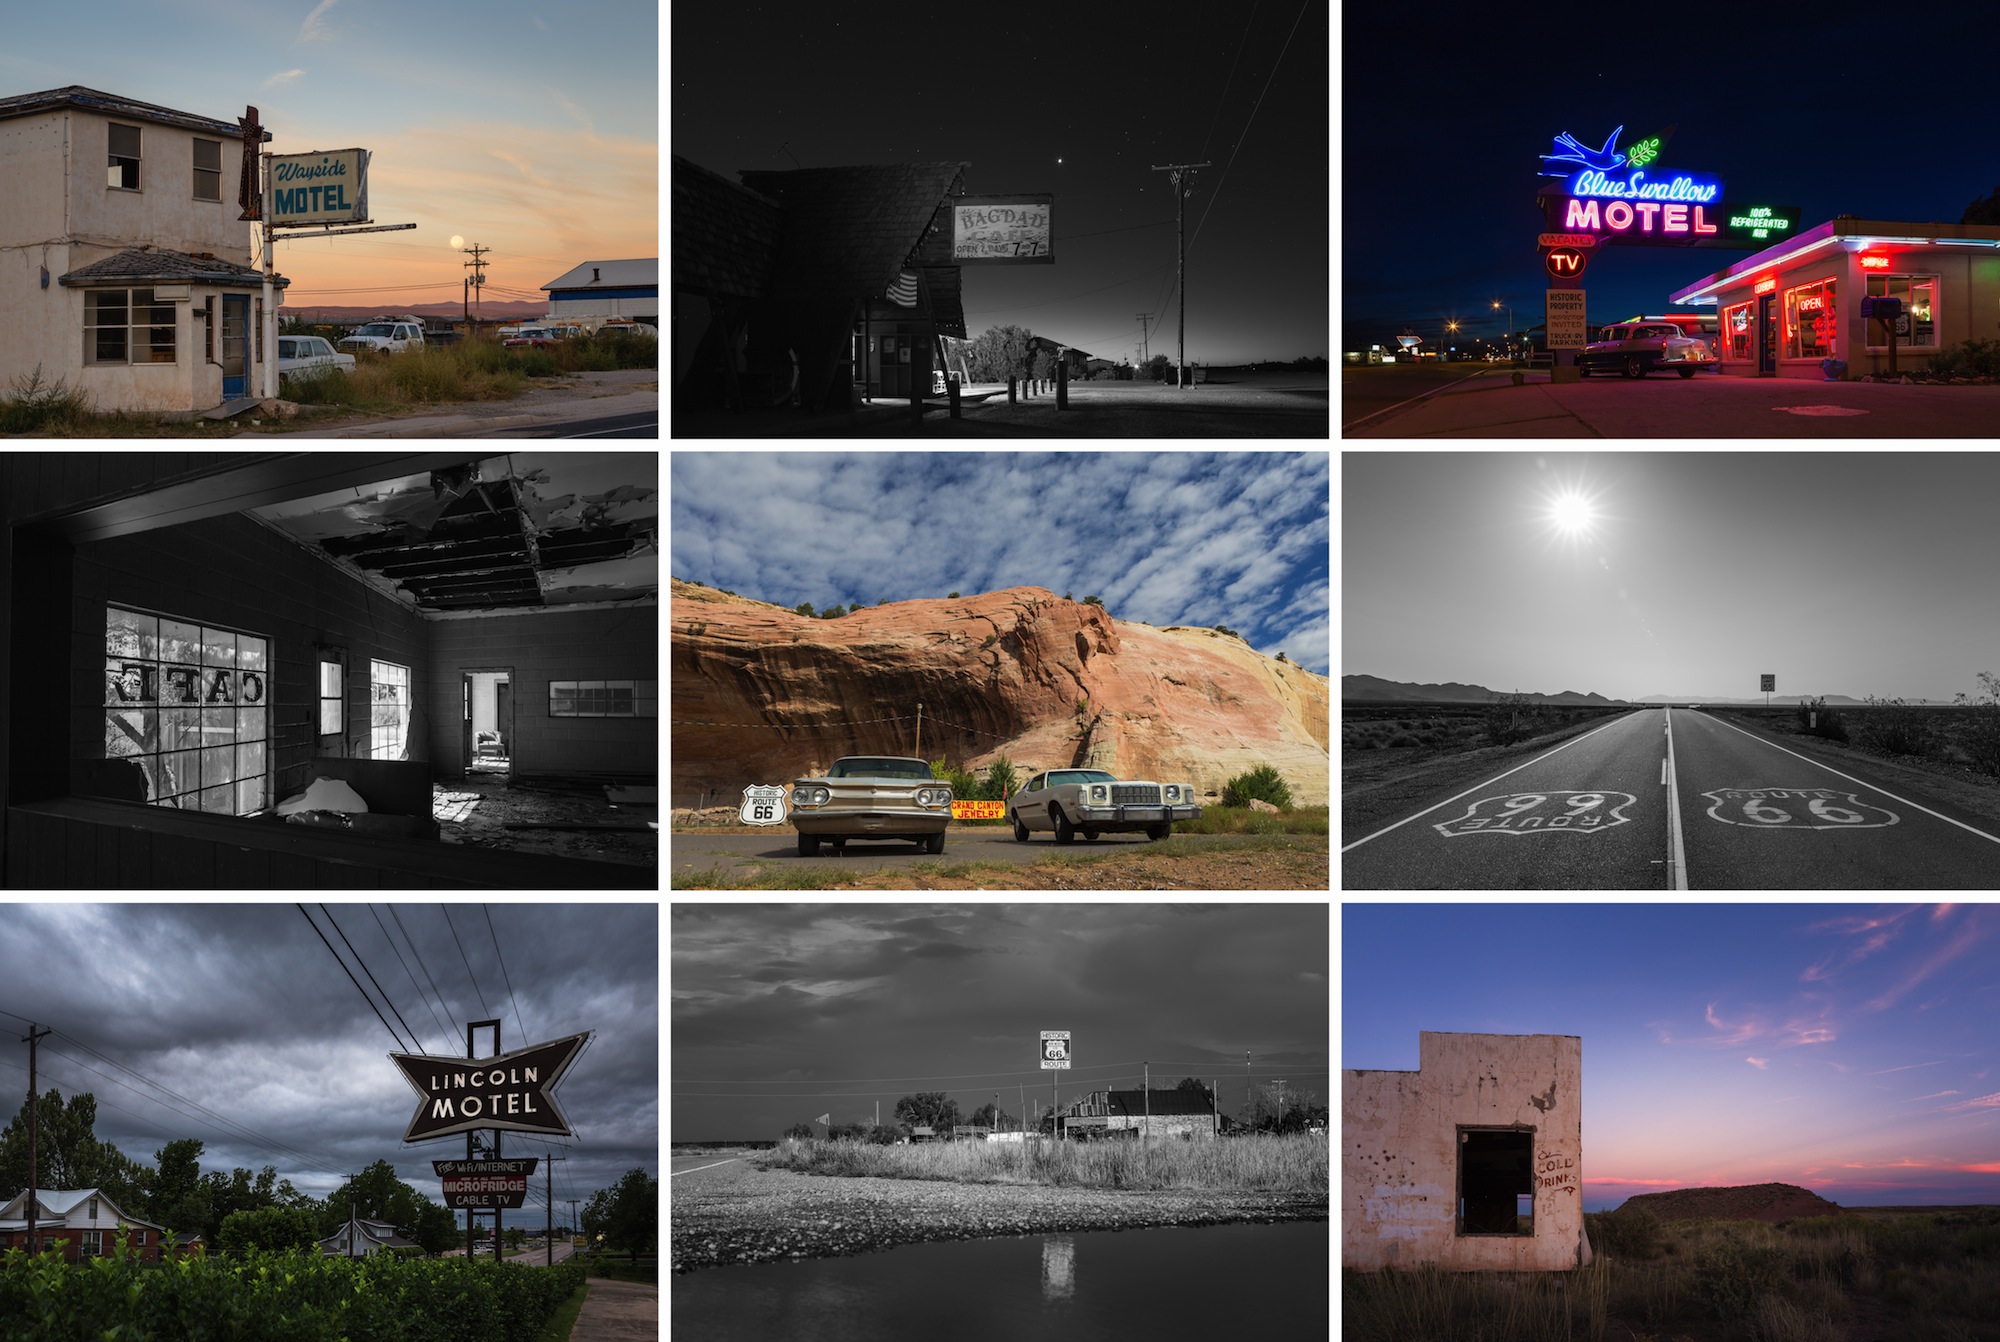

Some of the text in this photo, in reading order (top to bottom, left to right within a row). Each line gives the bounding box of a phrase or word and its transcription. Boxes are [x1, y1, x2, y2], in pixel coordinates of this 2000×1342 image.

[274, 157, 346, 182] Wayside
[1575, 170, 1717, 202] Blue Swallow
[275, 184, 352, 215] MOTEL
[961, 208, 1047, 230] BAGDAD
[1565, 199, 1718, 233] MOTEL
[1730, 216, 1789, 230] REFRIGERATED
[1541, 235, 1593, 245] VACANCY
[1013, 242, 1020, 256] 7
[1031, 242, 1038, 256] 7
[1551, 255, 1580, 270] TV
[1549, 293, 1583, 301] HISTORIC
[1800, 297, 1822, 311] OPEN
[1549, 302, 1584, 311] PROPERTY
[1551, 321, 1583, 329] INVITED
[1550, 339, 1584, 347] PARKING
[752, 798, 777, 806] ROUTE
[1725, 790, 1837, 800] ROUTE
[951, 800, 1005, 810] GRAND CANYON
[1742, 799, 1865, 824] 66
[753, 805, 774, 820] 66
[957, 809, 1000, 819] JEWELRY
[1459, 815, 1603, 830] ROUTE
[1049, 1050, 1062, 1058] 66
[431, 1066, 538, 1091] LINCOLN
[431, 1092, 537, 1119] MOTEL
[443, 1181, 525, 1192] MICROFRIDGE
[456, 1195, 510, 1206] CABLE TV
